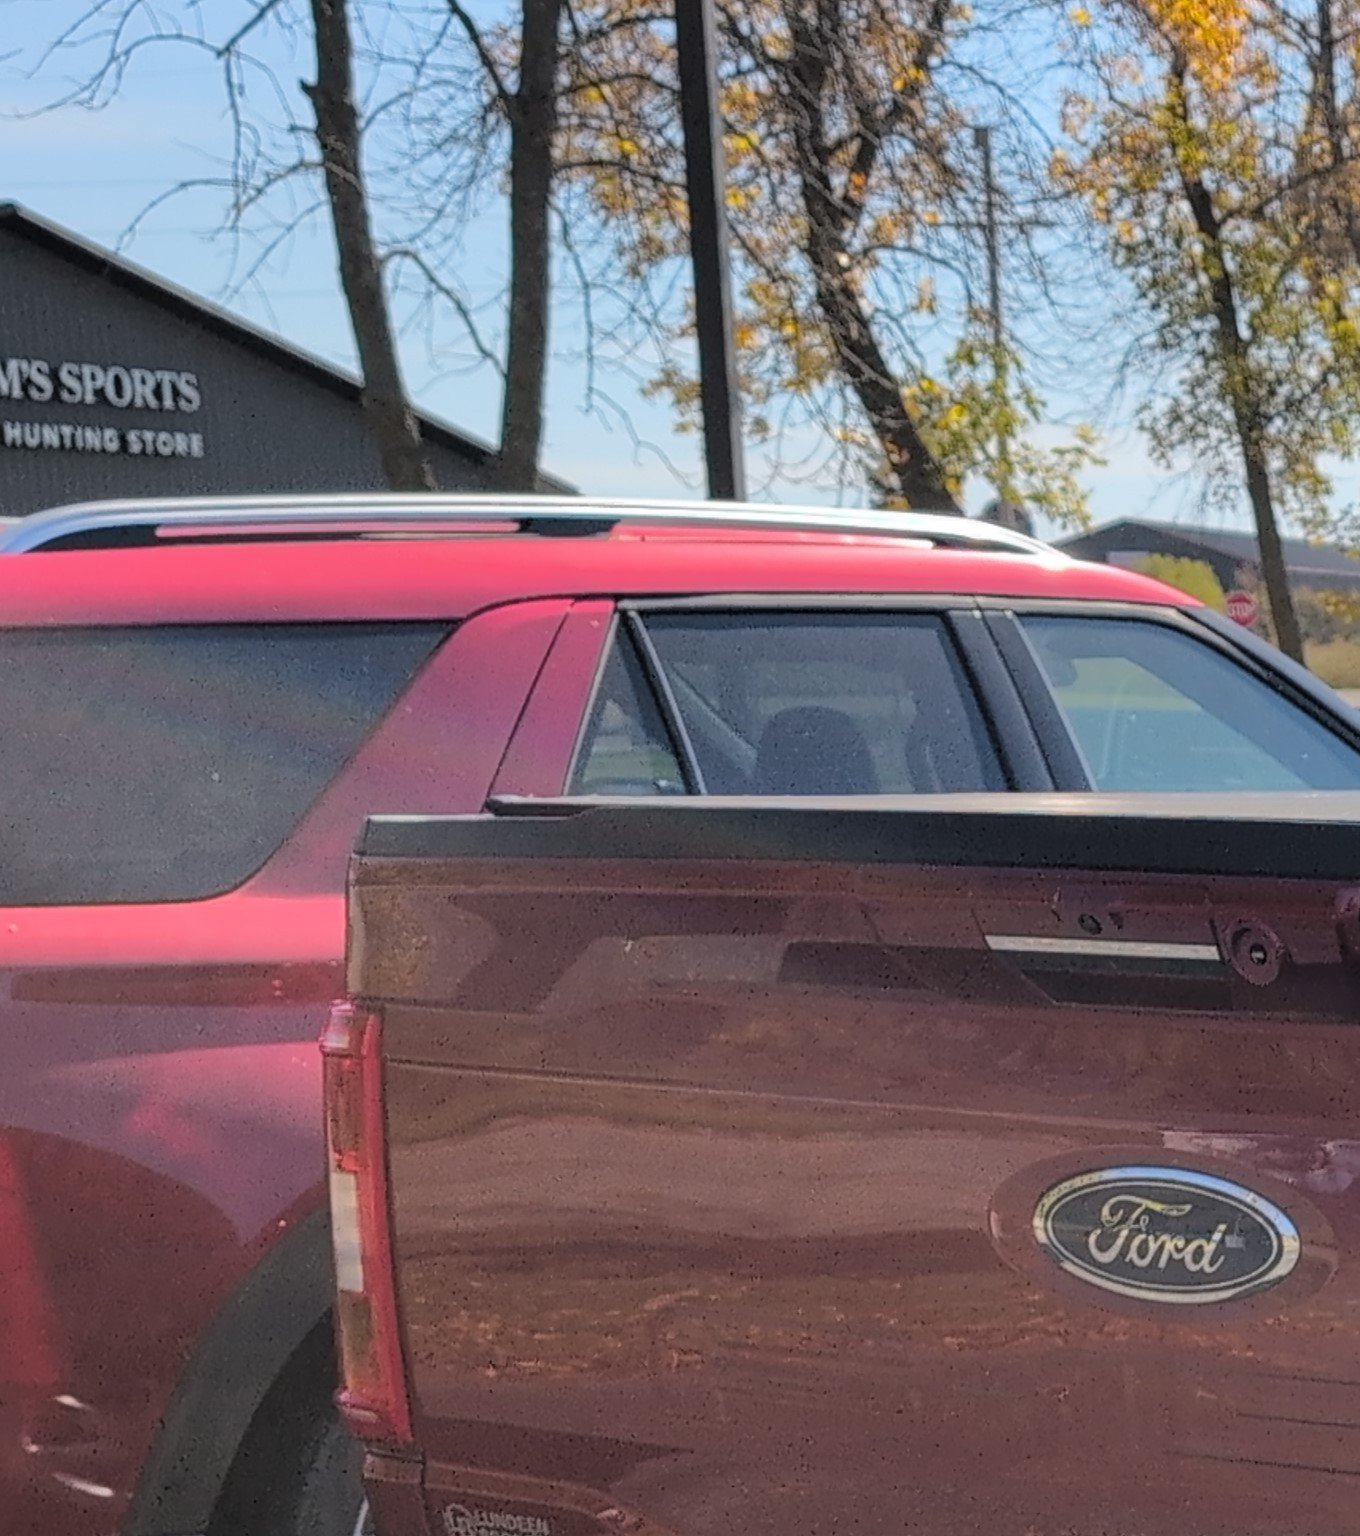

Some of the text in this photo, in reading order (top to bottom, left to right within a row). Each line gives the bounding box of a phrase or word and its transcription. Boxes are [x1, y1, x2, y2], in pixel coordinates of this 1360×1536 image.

[58, 361, 201, 414] SPORTS
[3, 420, 204, 459] HUNTING STORE
[1088, 1195, 1227, 1274] Ford
